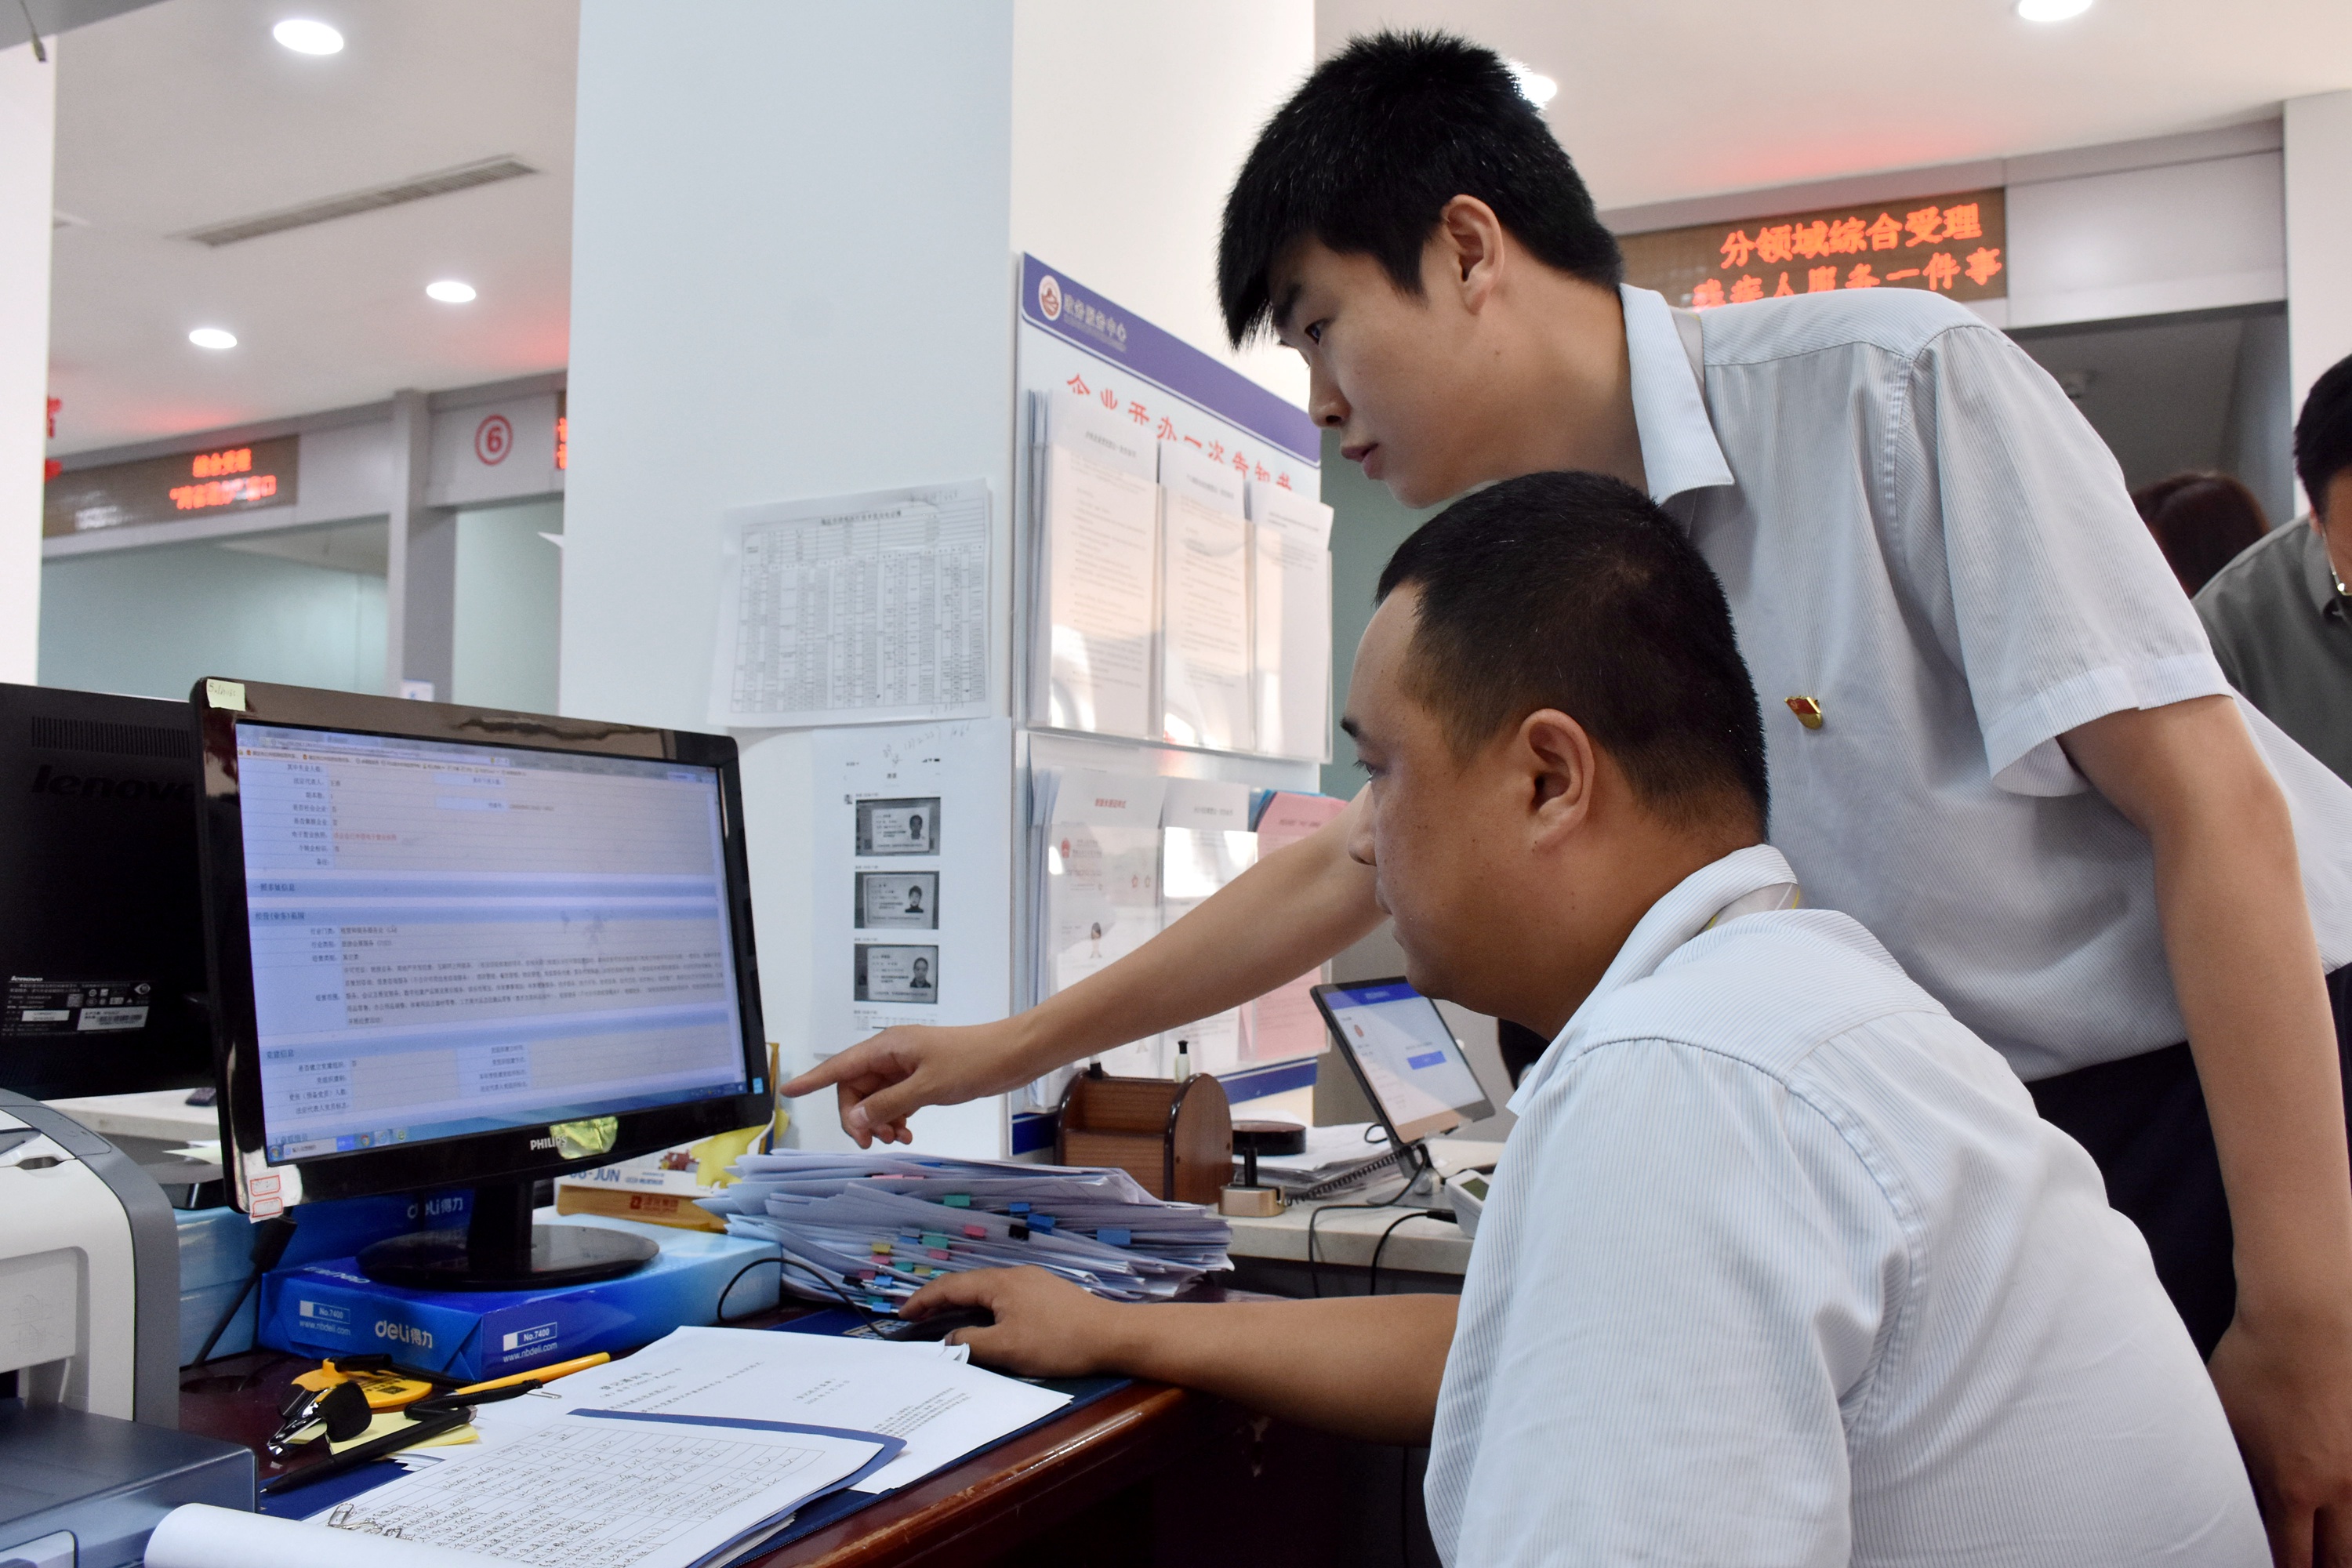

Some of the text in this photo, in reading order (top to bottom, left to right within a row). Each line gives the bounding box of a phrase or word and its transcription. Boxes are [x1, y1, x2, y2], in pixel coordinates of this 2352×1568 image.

[1720, 201, 1983, 269] 分领域综合受理
[299, 1320, 351, 1337] www.nbdeli.com
[523, 1328, 550, 1341] No.7400
[503, 1342, 557, 1363] www.nbdeli.com
